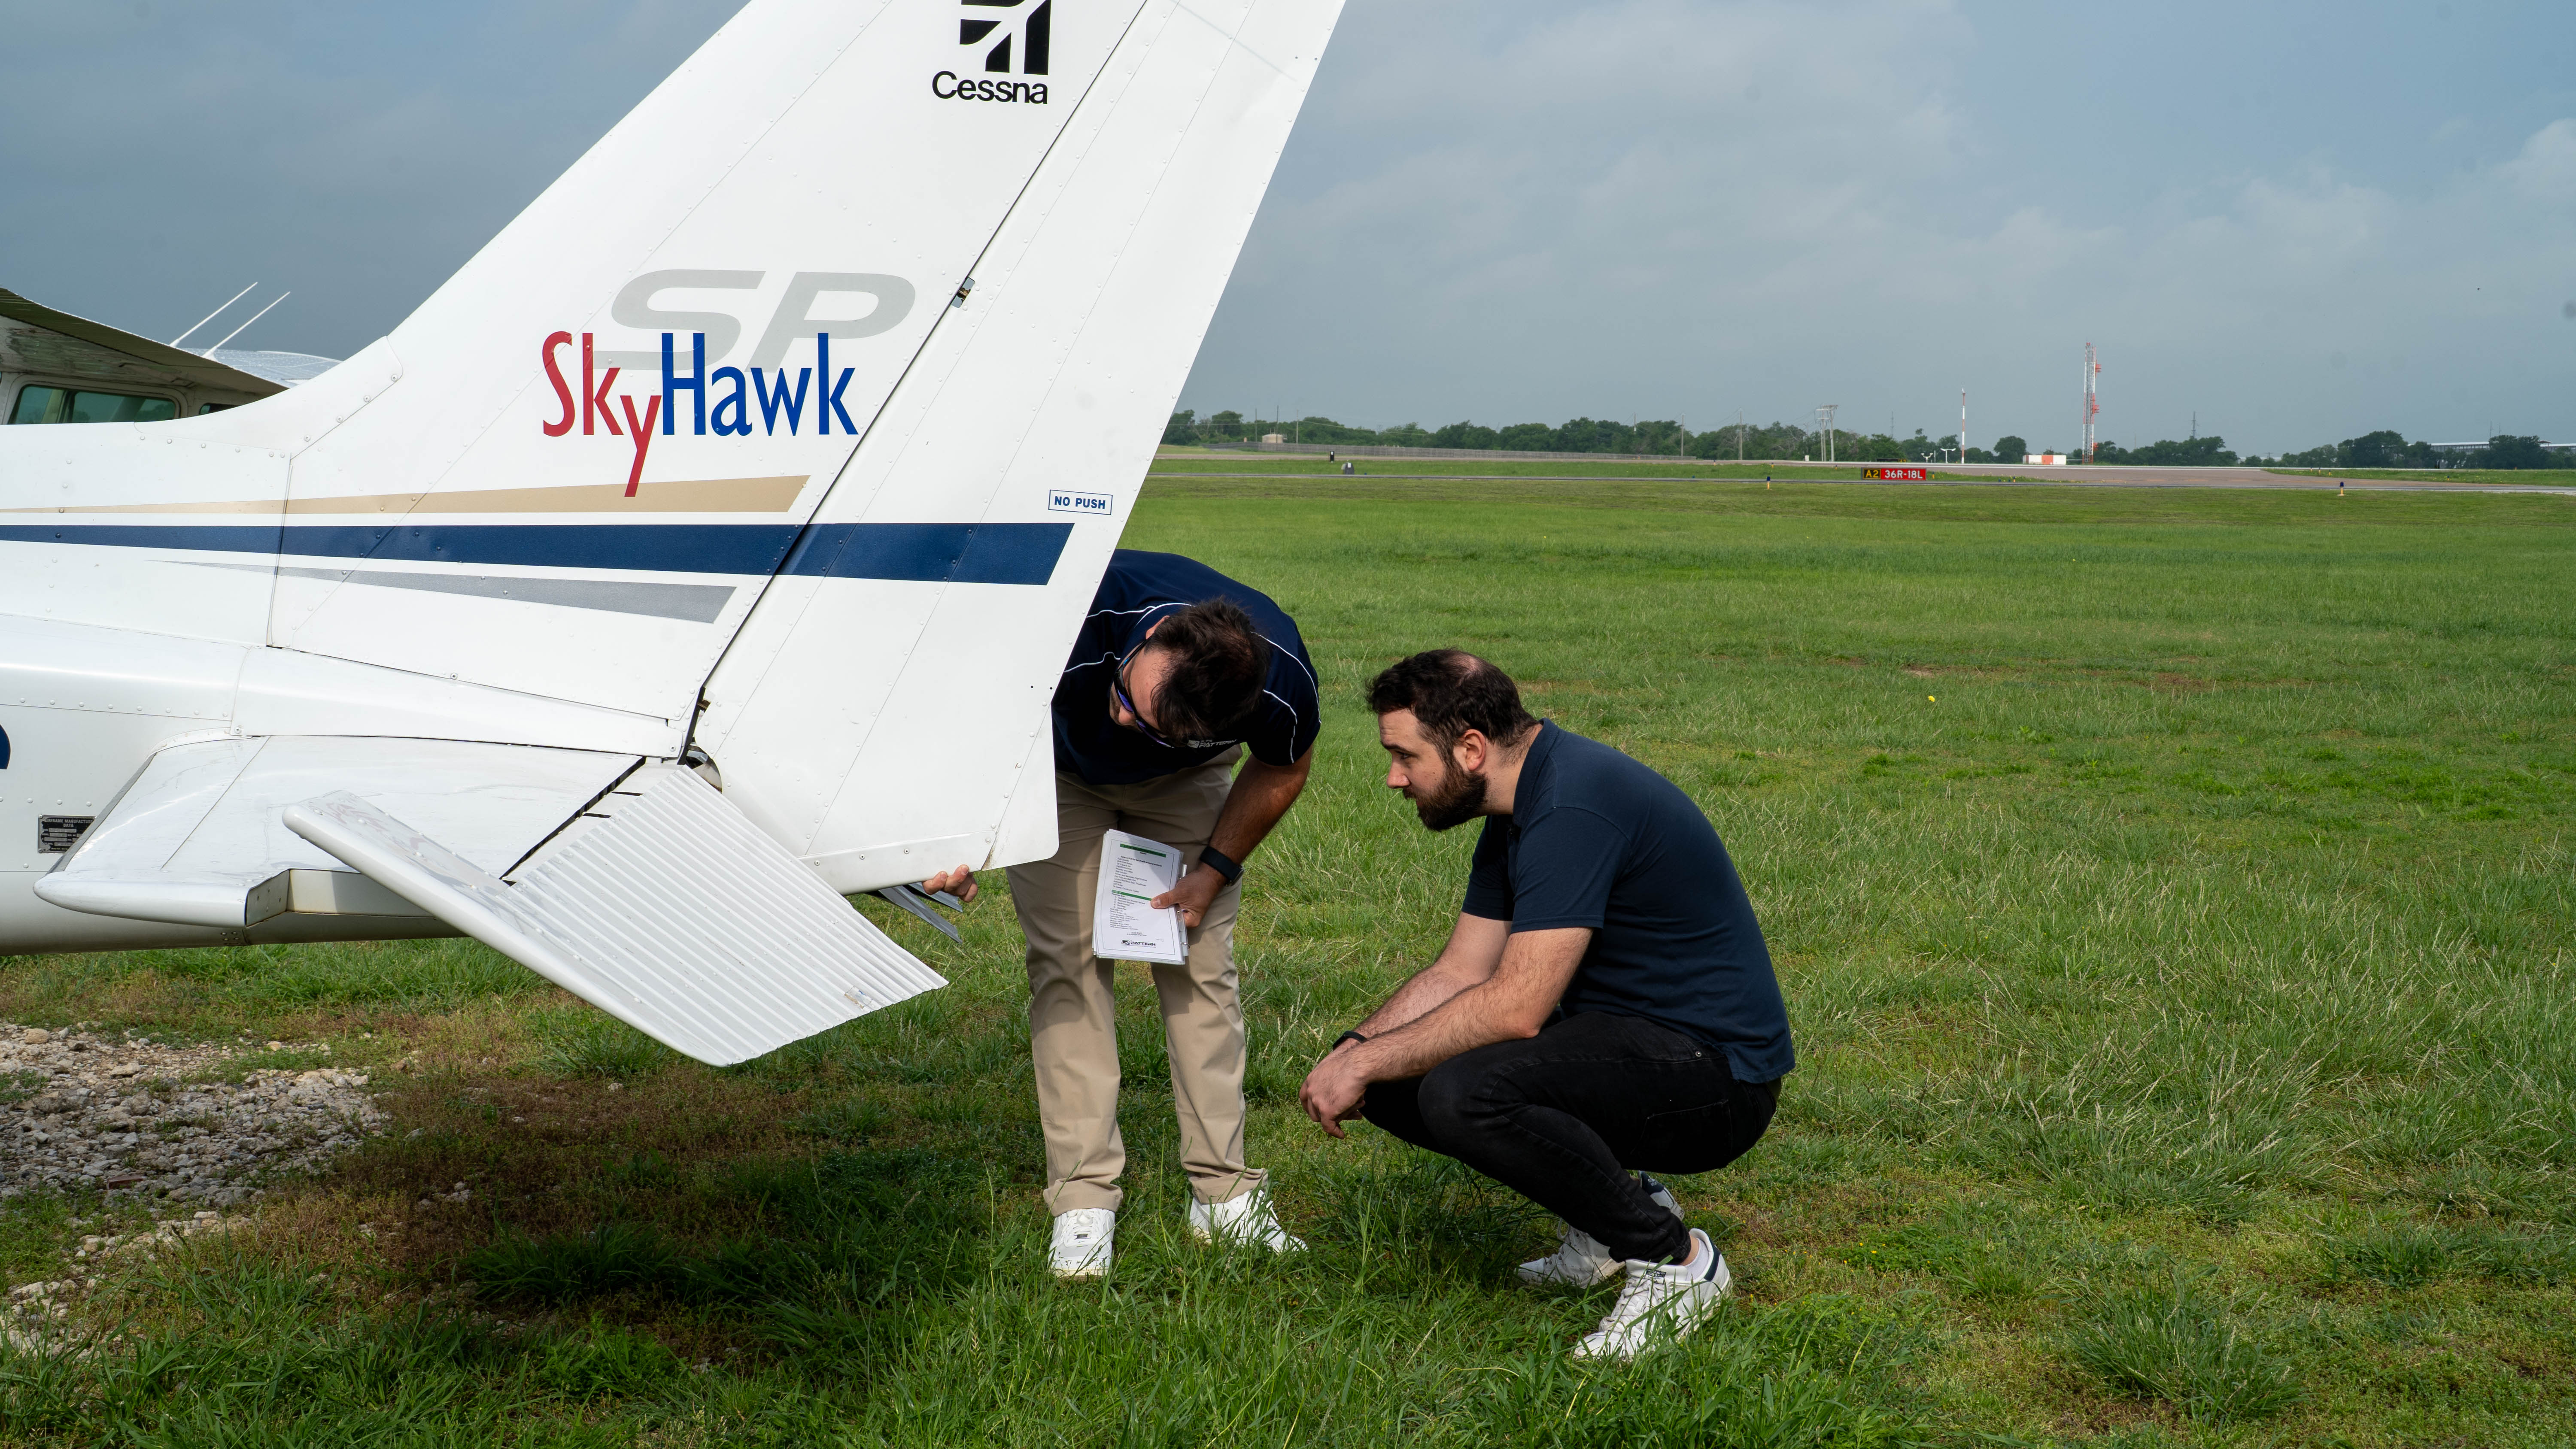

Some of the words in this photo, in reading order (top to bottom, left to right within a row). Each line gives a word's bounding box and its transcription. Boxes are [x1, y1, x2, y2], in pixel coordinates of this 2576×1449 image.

[932, 71, 1048, 104] Cessna
[593, 269, 916, 373] SP
[542, 331, 859, 497] SkyHawk
[1885, 470, 1923, 479] 36R-18L
[1054, 496, 1070, 506] NO
[1075, 498, 1106, 509] PUSH
